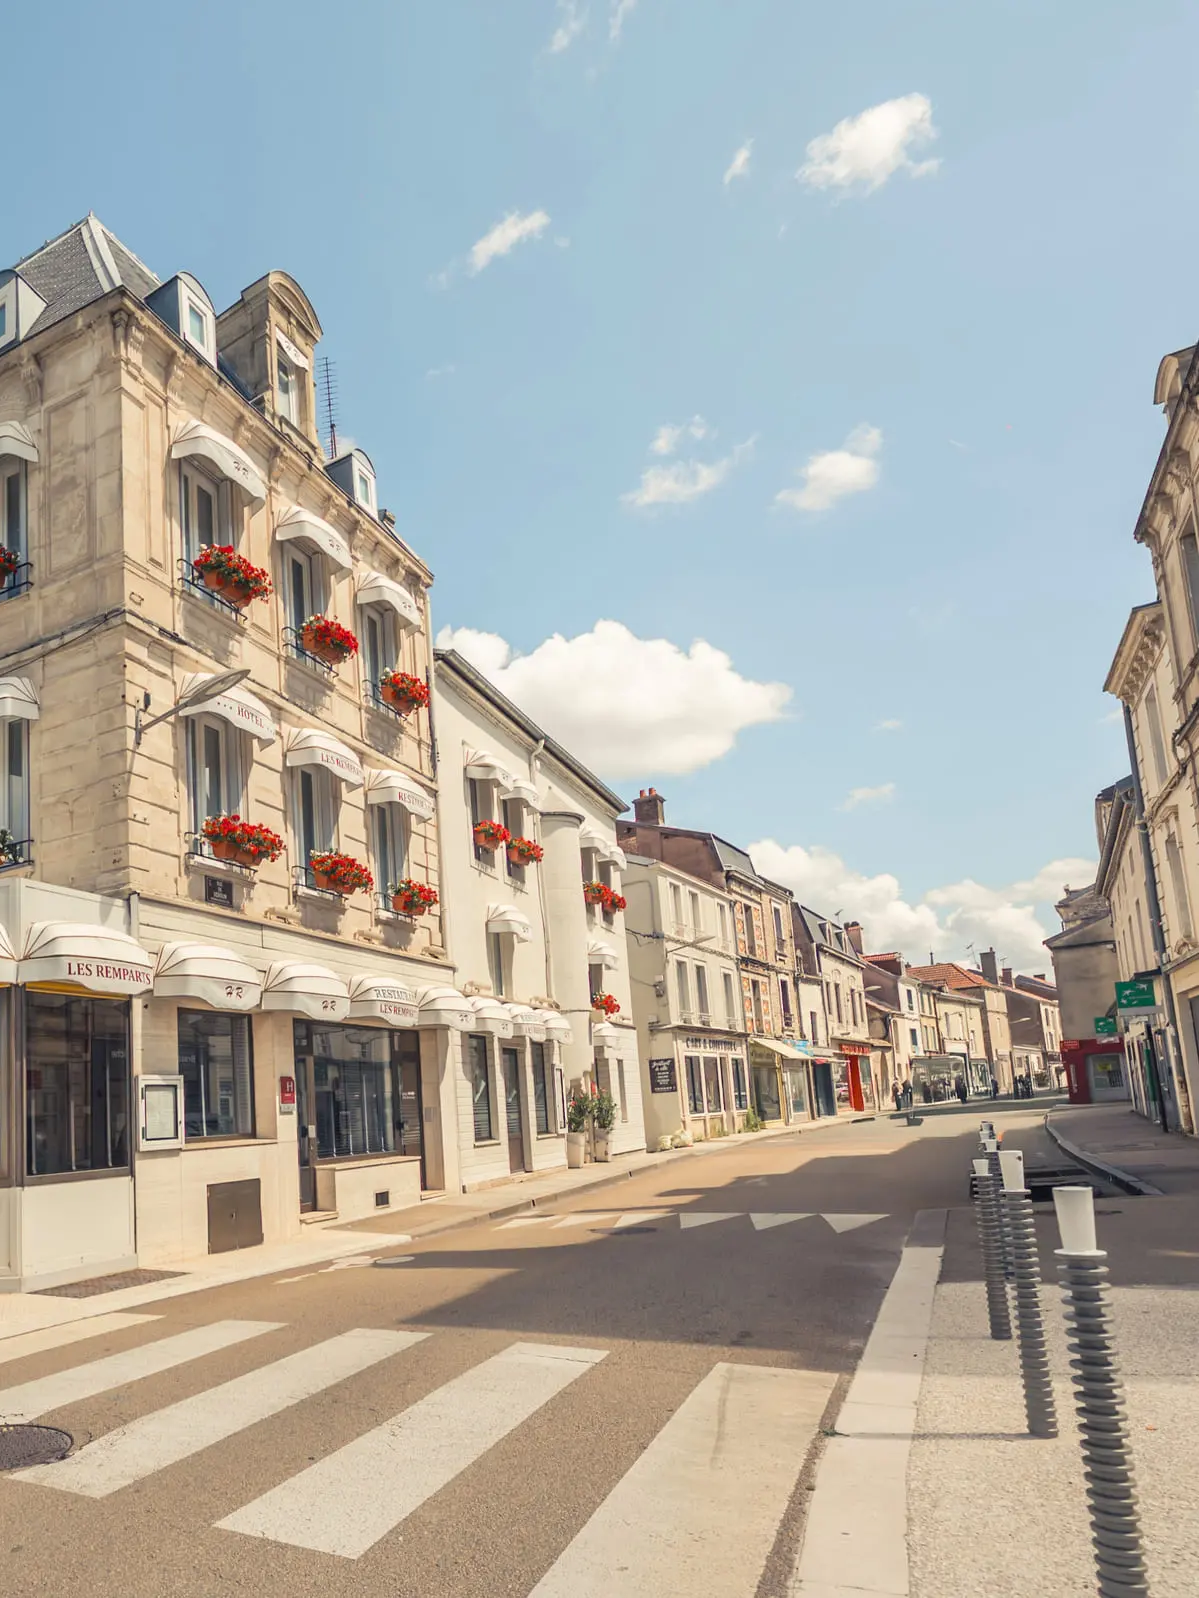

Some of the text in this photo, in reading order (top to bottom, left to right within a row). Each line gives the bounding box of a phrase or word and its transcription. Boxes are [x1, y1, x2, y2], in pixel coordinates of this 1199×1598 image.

[237, 703, 265, 729] HOTEL
[67, 962, 152, 985] LES REMPARTS
[379, 1003, 393, 1014] LES
